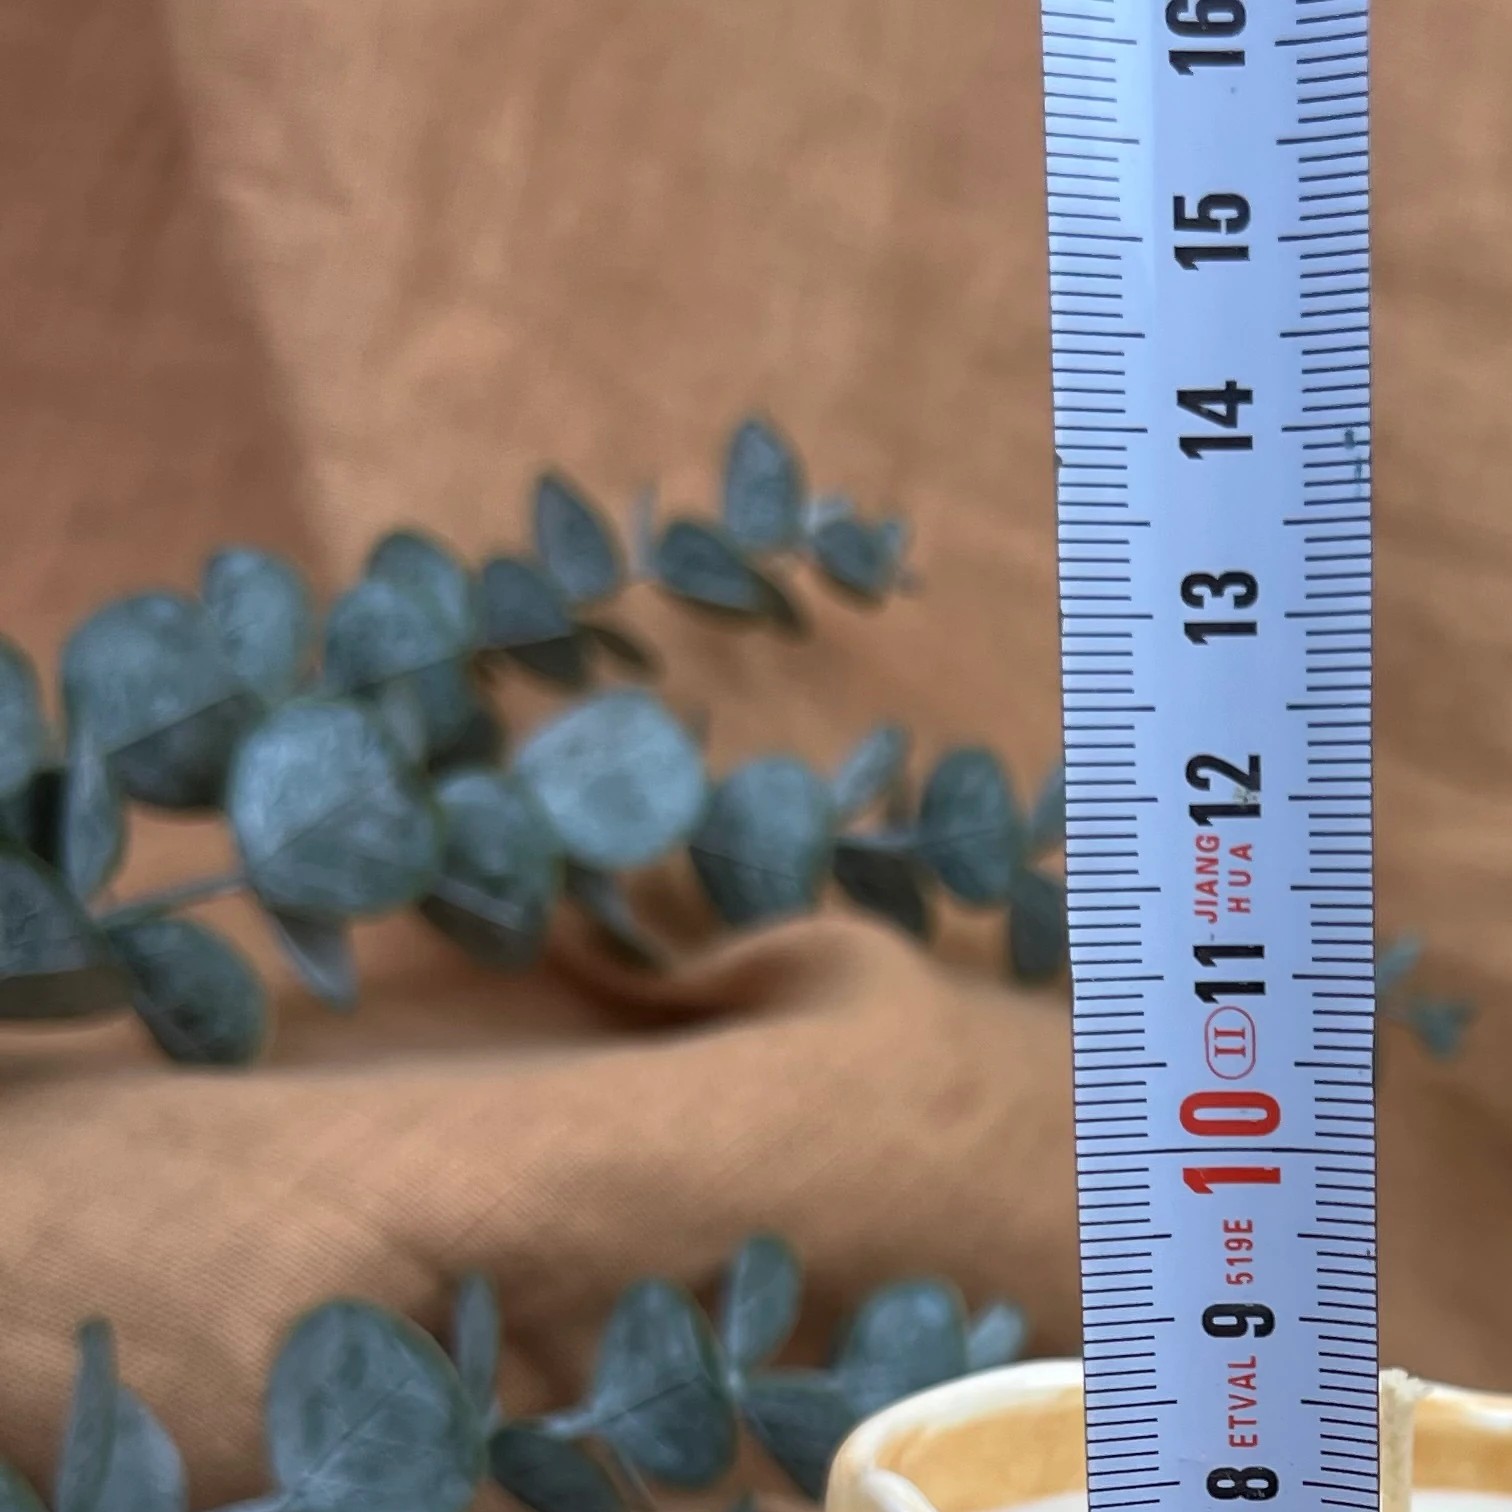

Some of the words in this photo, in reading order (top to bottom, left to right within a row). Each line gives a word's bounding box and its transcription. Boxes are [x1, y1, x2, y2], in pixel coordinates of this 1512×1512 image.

[1166, 0, 1246, 75] 16
[1173, 193, 1251, 271] 15
[1177, 380, 1253, 459] 14
[1181, 571, 1258, 645] 13
[1186, 754, 1261, 827] 12
[1194, 834, 1220, 923] JIANG
[1193, 944, 1265, 1004] 11
[1214, 1028, 1246, 1057] II
[1180, 1091, 1281, 1194] 10
[1224, 1219, 1253, 1284] 519E
[1202, 1303, 1275, 1338] 9
[1228, 1355, 1258, 1447] ETVAL
[1206, 1466, 1279, 1500] 8
